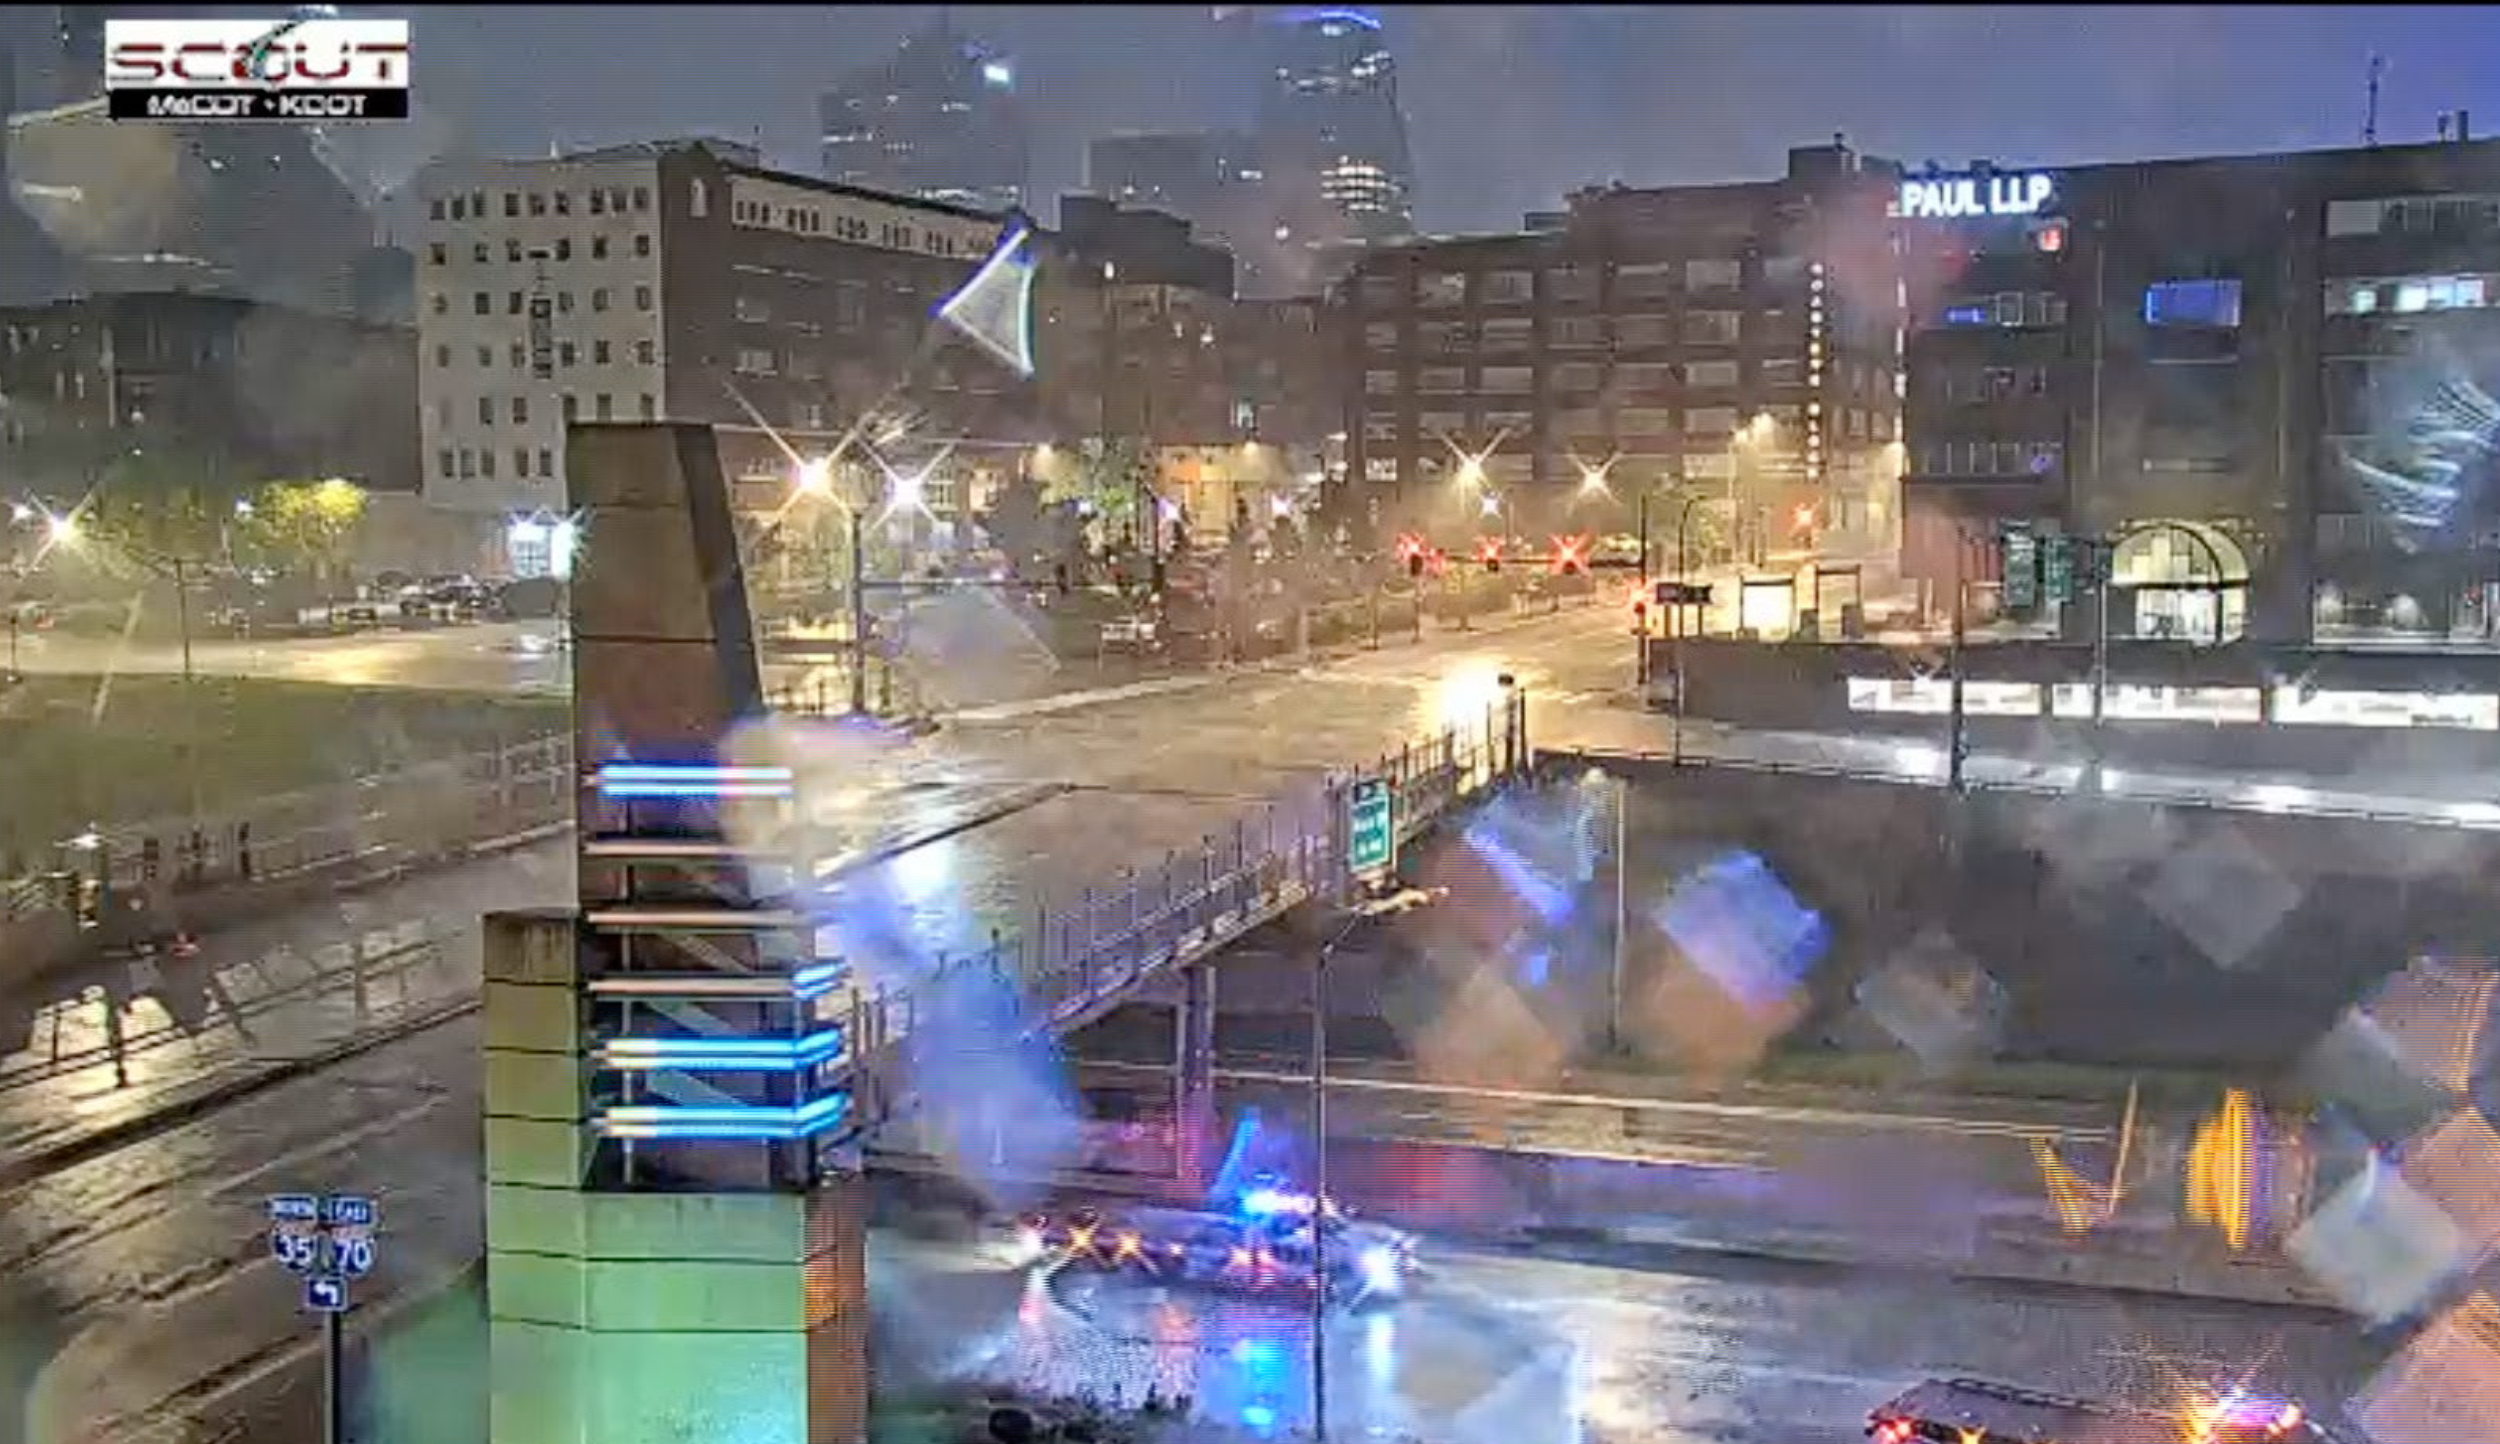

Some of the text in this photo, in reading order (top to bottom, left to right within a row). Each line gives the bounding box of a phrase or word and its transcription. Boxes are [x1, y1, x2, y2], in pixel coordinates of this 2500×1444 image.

[1902, 174, 2052, 217] PAUL LLP
[277, 1233, 312, 1264] 35
[334, 1239, 372, 1272] 70
